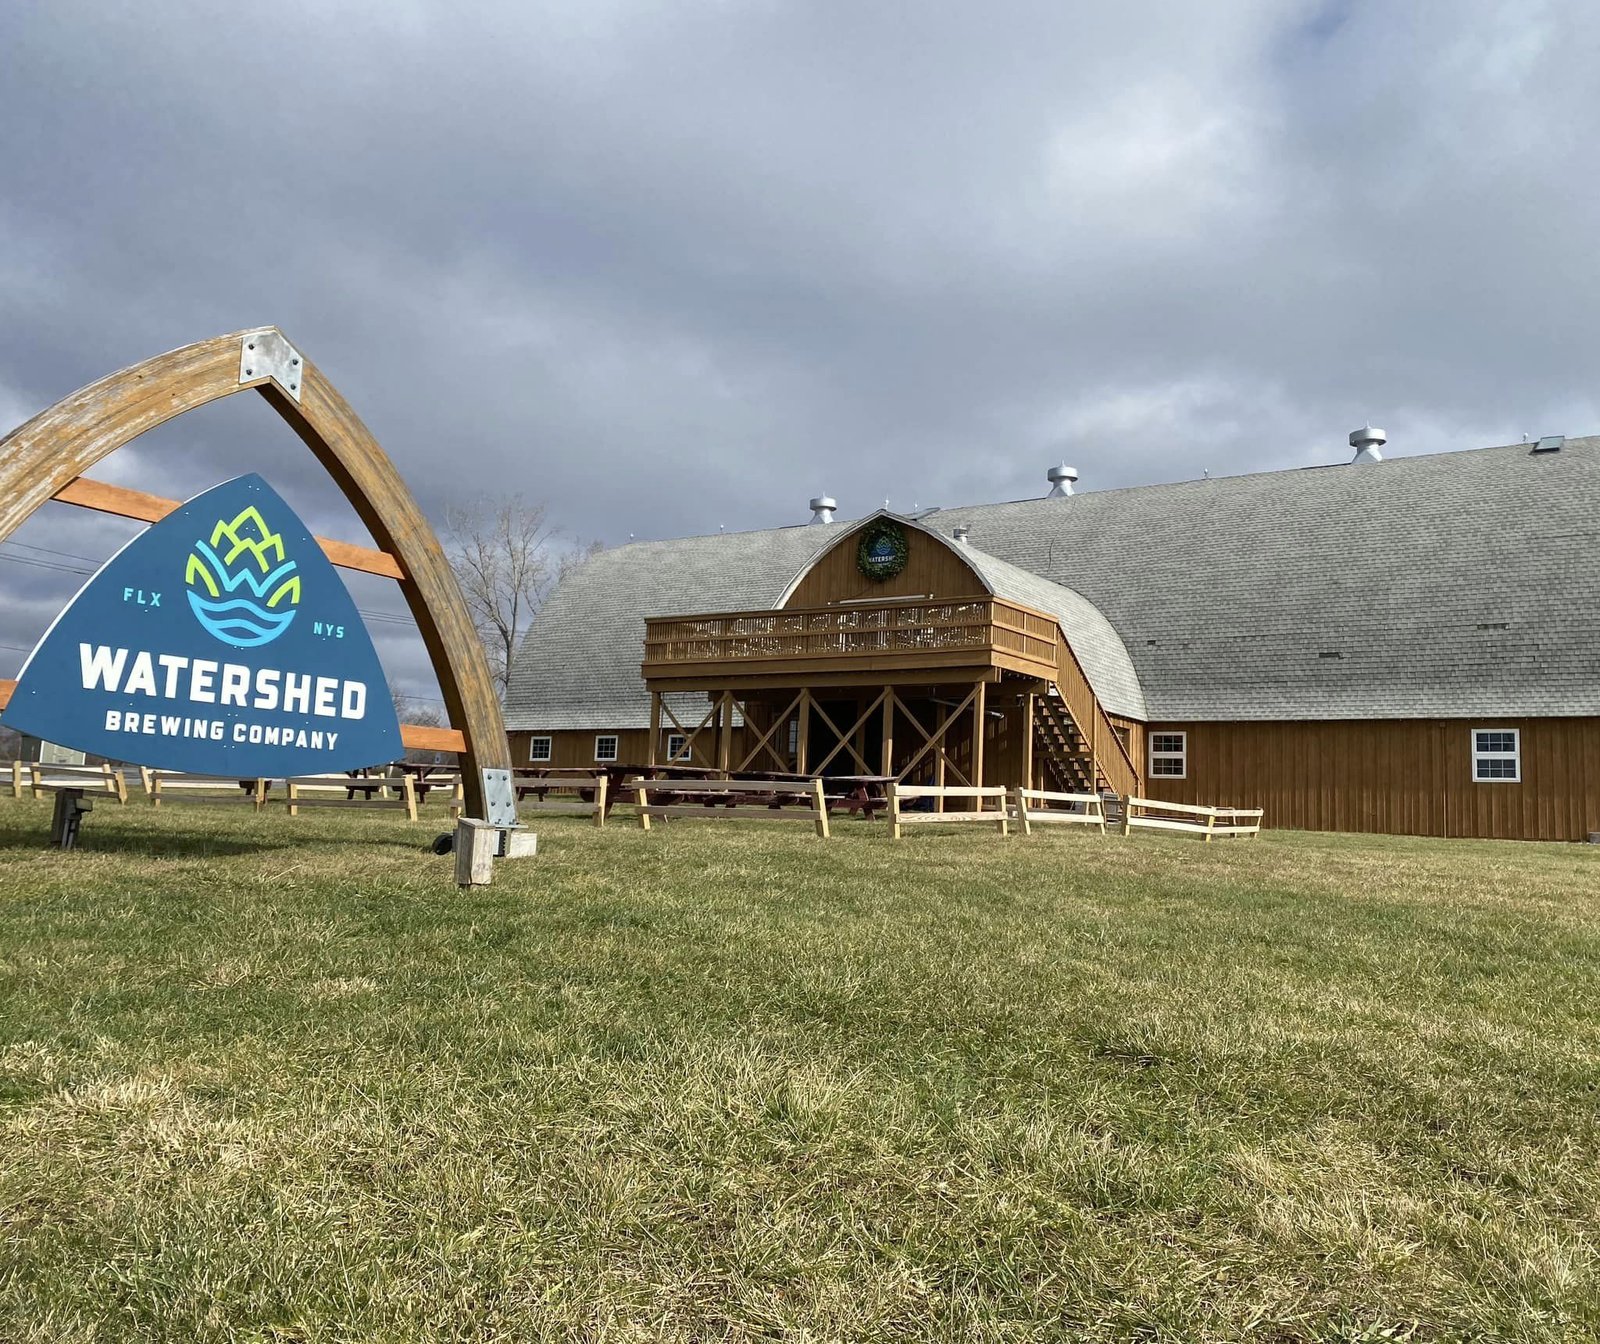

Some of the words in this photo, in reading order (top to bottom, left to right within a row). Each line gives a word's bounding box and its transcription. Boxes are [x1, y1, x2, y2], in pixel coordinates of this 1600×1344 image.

[123, 587, 162, 607] FLX
[313, 621, 345, 639] NYS
[79, 643, 367, 721] WATERSHED
[105, 711, 225, 741] BREWING
[232, 723, 339, 751] COMPANY
